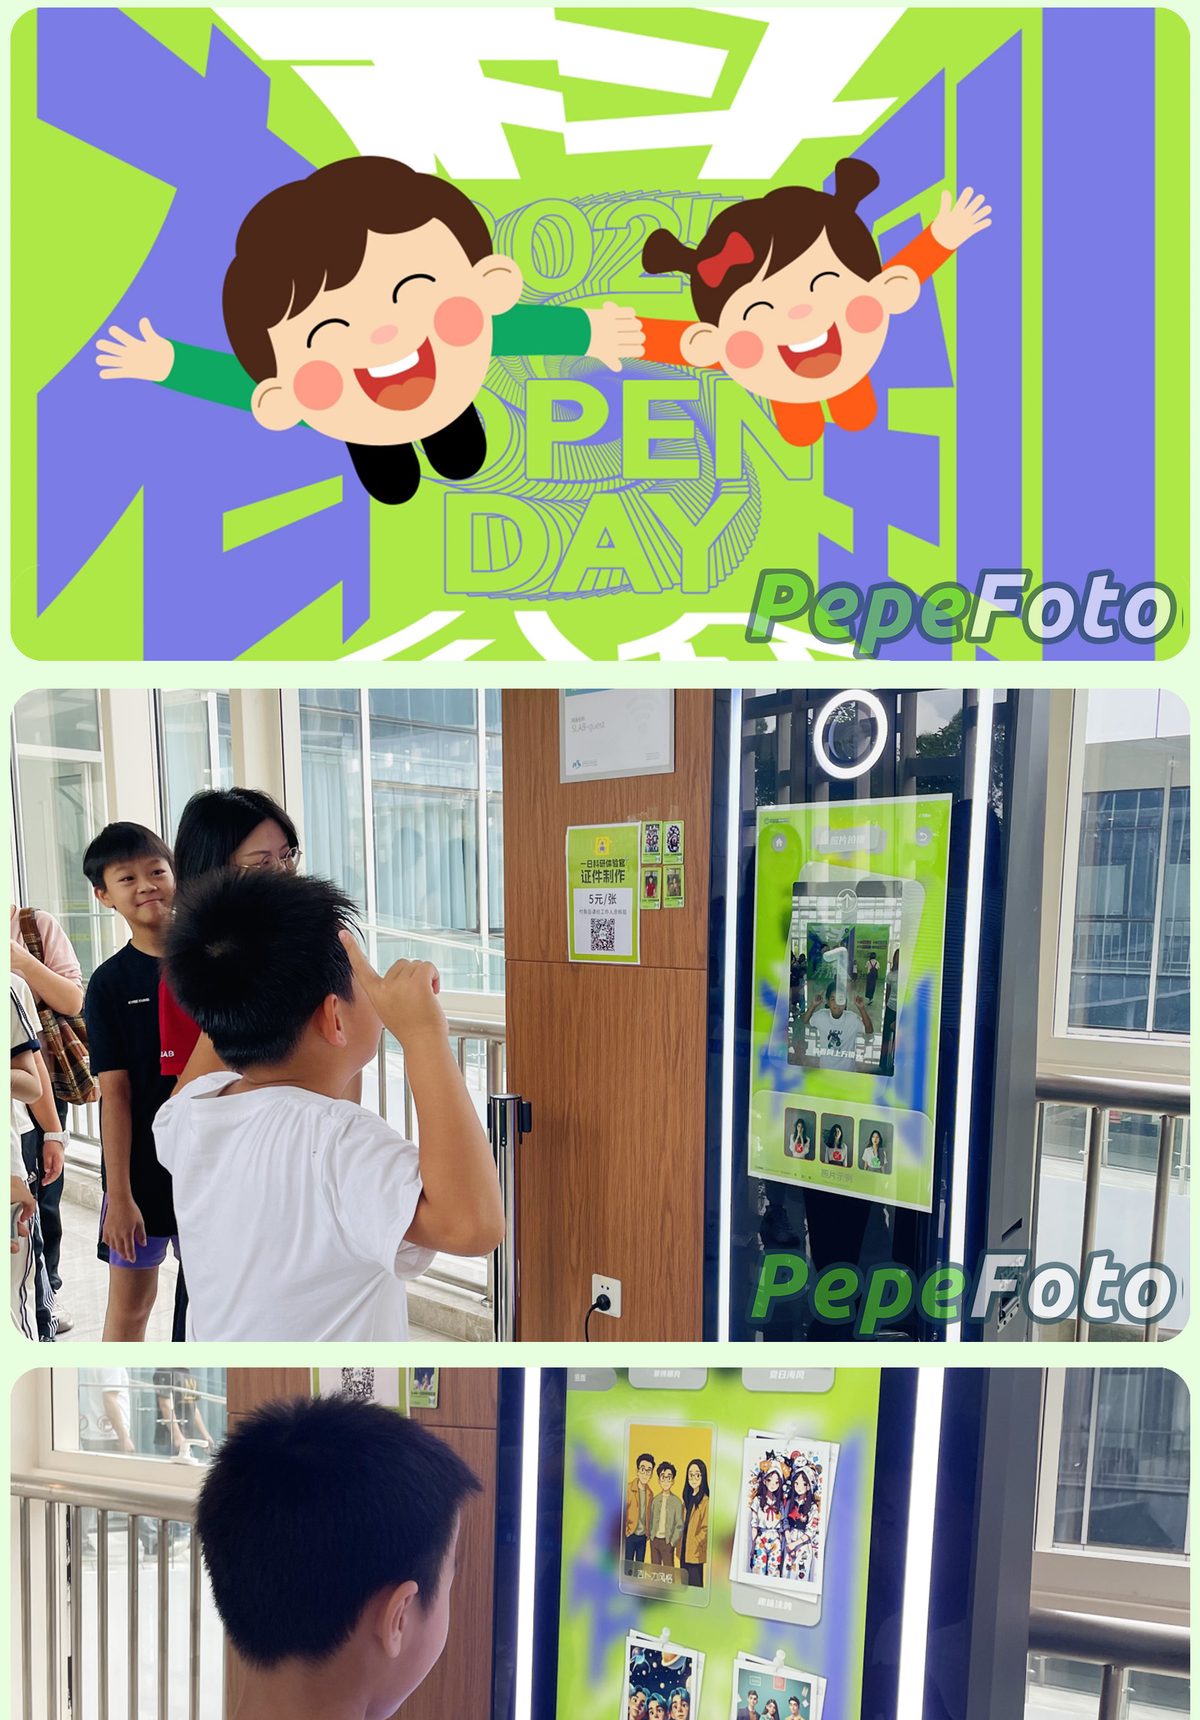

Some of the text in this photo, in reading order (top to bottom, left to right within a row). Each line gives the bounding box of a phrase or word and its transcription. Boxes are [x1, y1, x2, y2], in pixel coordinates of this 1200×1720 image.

[444, 490, 762, 600] DAY
[580, 858, 626, 869] 一日科研体验官
[580, 869, 626, 884] 证件制作
[588, 893, 617, 905] 5元/张
